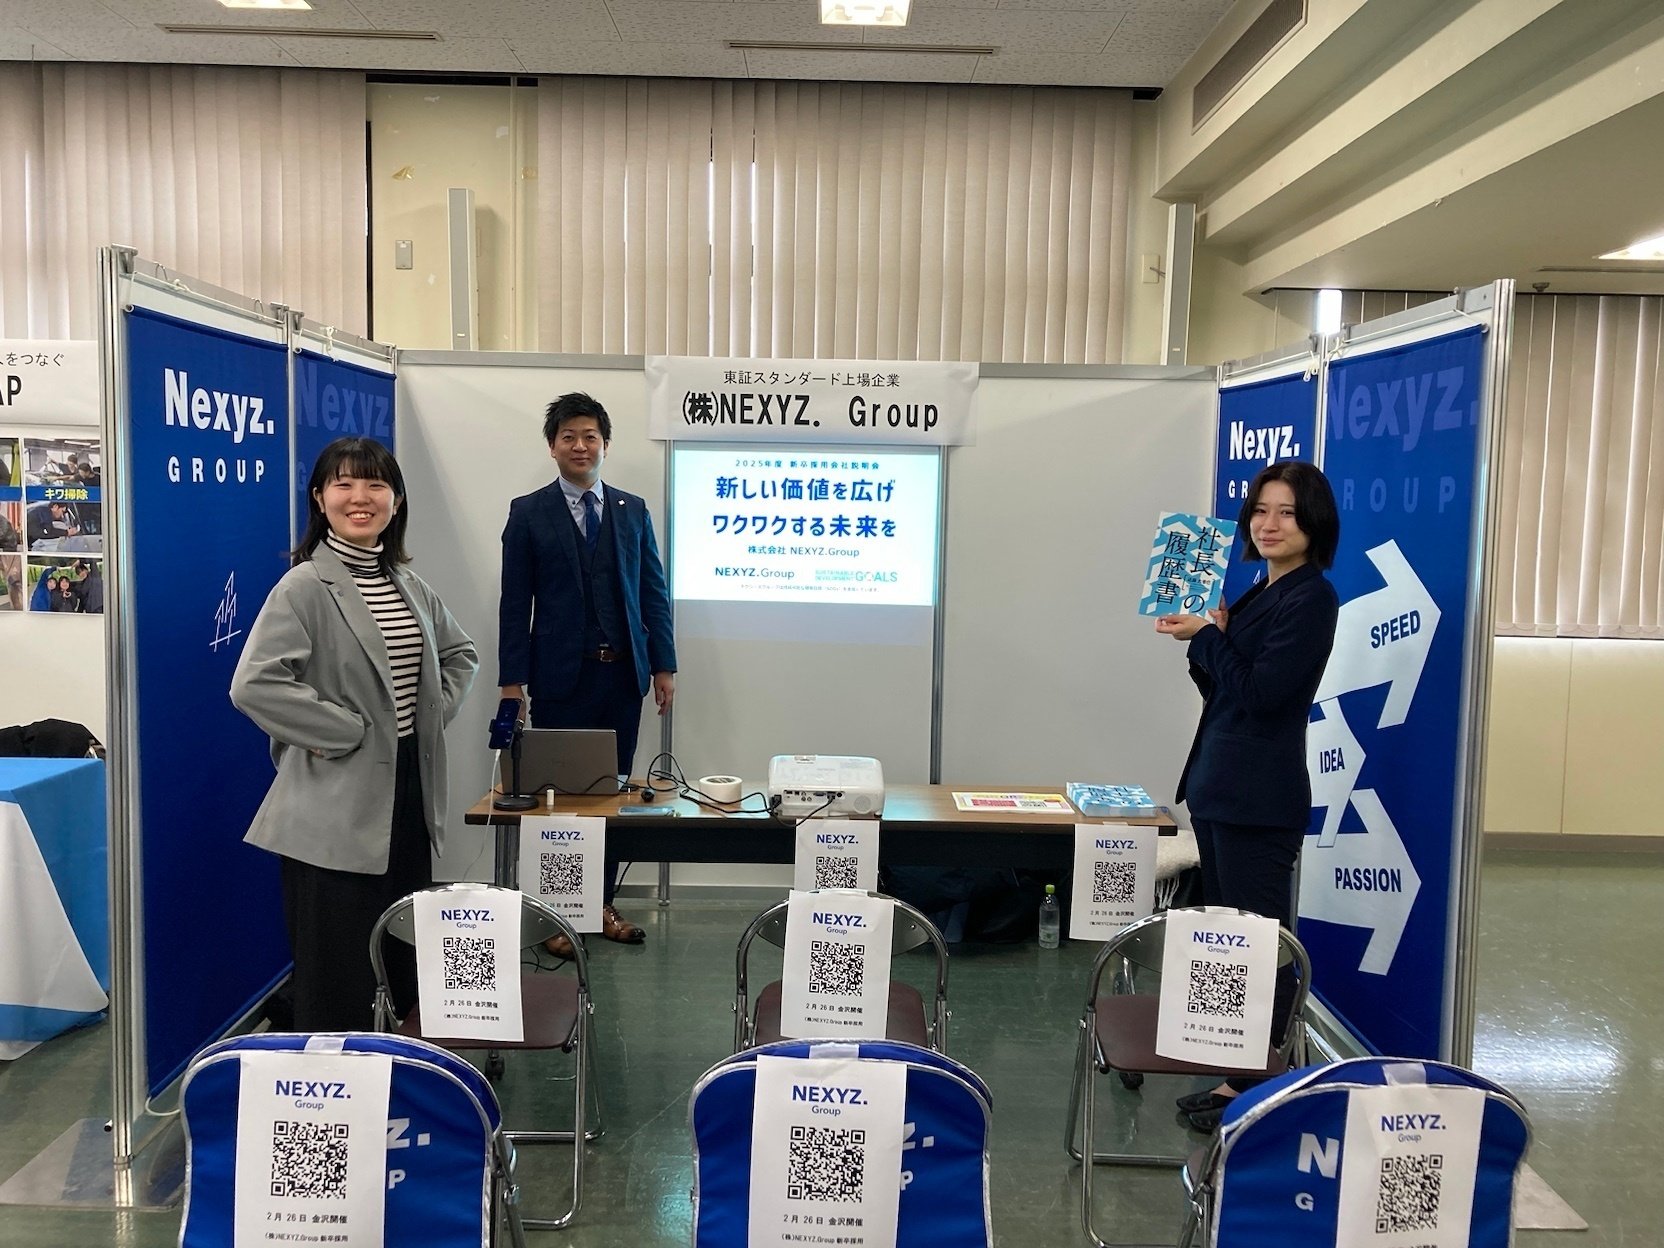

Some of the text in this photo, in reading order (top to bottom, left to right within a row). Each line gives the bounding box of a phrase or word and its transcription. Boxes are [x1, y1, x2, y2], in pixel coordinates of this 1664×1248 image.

[0, 352, 64, 367] をつなぐ
[723, 370, 900, 387] 東証スタンダード上場企業
[164, 368, 275, 443] Nexyz.
[682, 391, 939, 431] (株)NEXYZ. Group
[1229, 420, 1300, 467] Nexyz.
[168, 456, 265, 483] GROUP
[45, 488, 88, 500] キワ掃除
[715, 476, 896, 503] 新しい価値を広げ
[1343, 475, 1456, 514] ROUP
[713, 514, 896, 538] ワクワクする未来を
[748, 545, 860, 558] 株式会社 NEXYZ.Group
[715, 567, 795, 580] NEXYZ.Group
[1154, 531, 1191, 605] 履歴書
[1370, 609, 1421, 649] SPEED
[1319, 747, 1345, 774] IDEA
[541, 831, 584, 840] NEXYZ.
[816, 834, 859, 844] NEXYZ.
[1095, 839, 1138, 849] NEXYZ.
[1334, 866, 1402, 893] PASSION
[441, 910, 494, 922] NEXYZ.
[813, 912, 867, 928] NEXYZ.
[456, 922, 477, 930] Group
[826, 926, 848, 936] Group
[1193, 931, 1250, 948] NEXYZ.
[1208, 946, 1230, 955] Group
[275, 1080, 352, 1099] NEXYZ.
[792, 1085, 868, 1106] NEXYZ.
[295, 1100, 324, 1111] Group
[812, 1105, 841, 1116] Group
[1381, 1114, 1446, 1132] NEXYZ.
[1398, 1133, 1422, 1143] Group
[312, 1214, 348, 1224] 金沢開催
[828, 1218, 864, 1227] 金沢開催
